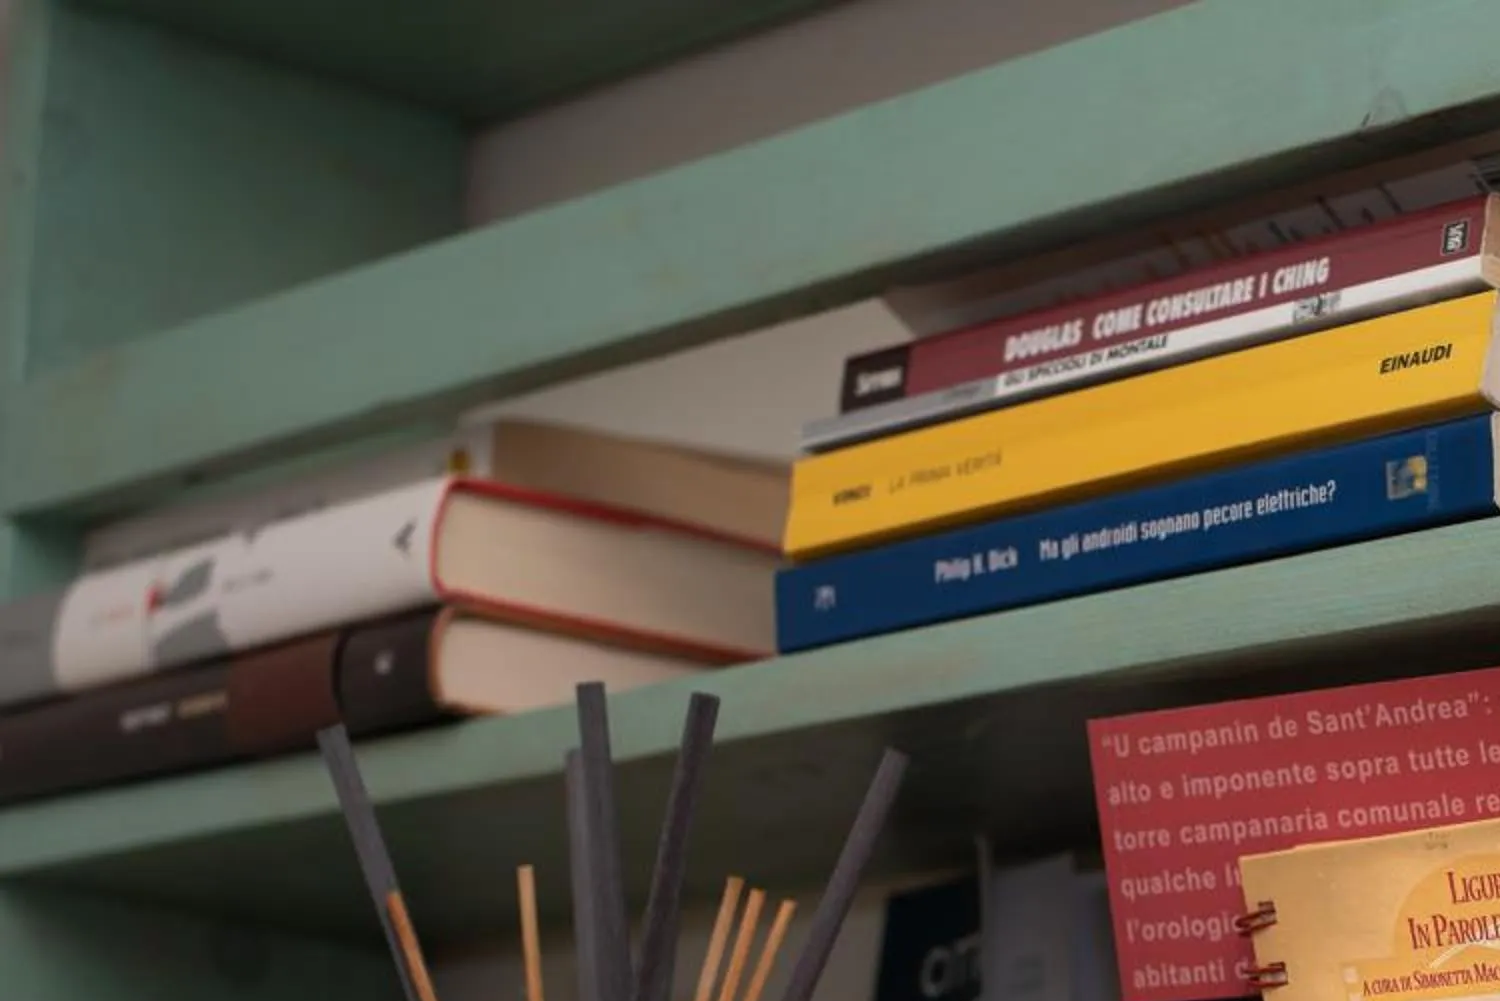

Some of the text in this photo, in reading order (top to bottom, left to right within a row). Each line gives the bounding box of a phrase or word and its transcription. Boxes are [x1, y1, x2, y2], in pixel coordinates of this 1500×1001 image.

[1004, 318, 1082, 362] DOUGLAS
[1092, 303, 1143, 340] COME
[1146, 273, 1256, 325] CONSULTARE
[1259, 272, 1269, 298] I
[1273, 257, 1330, 295] CHING
[1107, 335, 1169, 360] MONTALE
[1379, 343, 1453, 375] EINAUDI
[988, 546, 1018, 572] Dick
[1039, 538, 1060, 561] Ma
[1061, 533, 1080, 561] gli
[1081, 520, 1139, 552] androidi
[1140, 513, 1201, 544] sognano
[1202, 497, 1254, 530] pecore
[1256, 479, 1338, 515] elettriche?
[1137, 719, 1260, 759] campanin
[1267, 715, 1299, 738] de
[1107, 779, 1152, 806] alto
[1159, 783, 1176, 800] e
[1181, 760, 1318, 802] imponente
[1326, 755, 1400, 787] sopra
[1407, 742, 1472, 773] tutte
[1113, 825, 1171, 851] torre
[1179, 806, 1329, 850] campanaria
[1337, 793, 1466, 828] comunale
[1121, 866, 1217, 903] qualche
[1407, 915, 1432, 951] IN
[1133, 959, 1226, 990] abitanti
[1413, 966, 1475, 990] SIMONETTA
